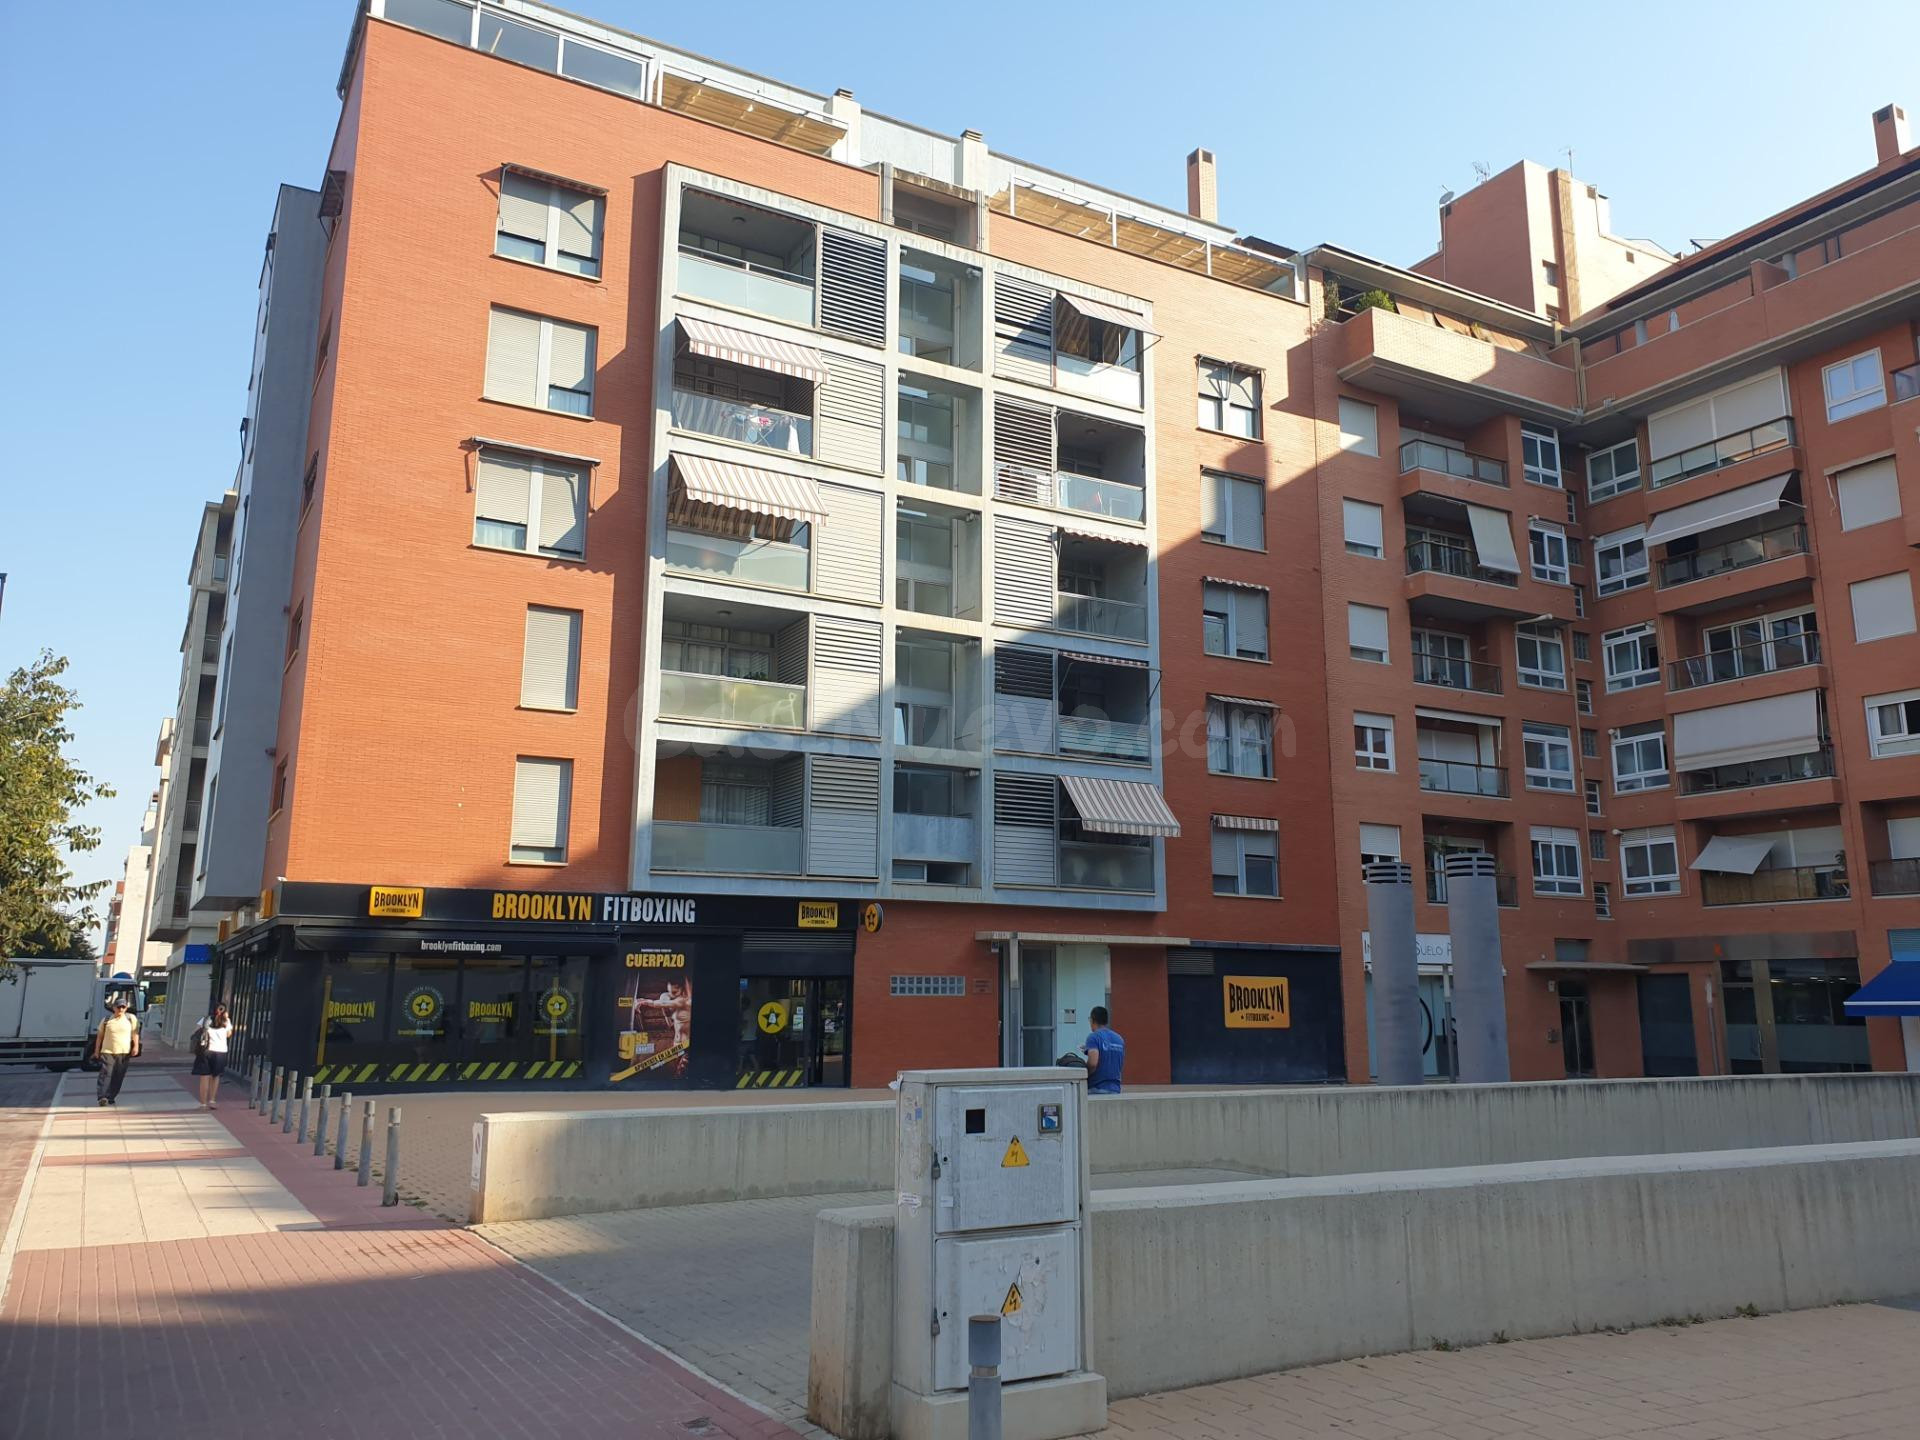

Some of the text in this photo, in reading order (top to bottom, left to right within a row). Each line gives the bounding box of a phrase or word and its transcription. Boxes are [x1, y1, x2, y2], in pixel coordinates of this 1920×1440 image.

[374, 890, 420, 909] BROOKLYN
[492, 892, 697, 923] BROOKLYN FITBOXING
[801, 905, 836, 921] BROOKLYN
[421, 940, 502, 954] brooklynfitboxing.com
[625, 953, 685, 968] CUERPAZO
[1228, 982, 1285, 1015] BROOKLYN
[328, 1001, 376, 1018] BROOKLYN
[469, 1001, 513, 1018] BROOKLYN
